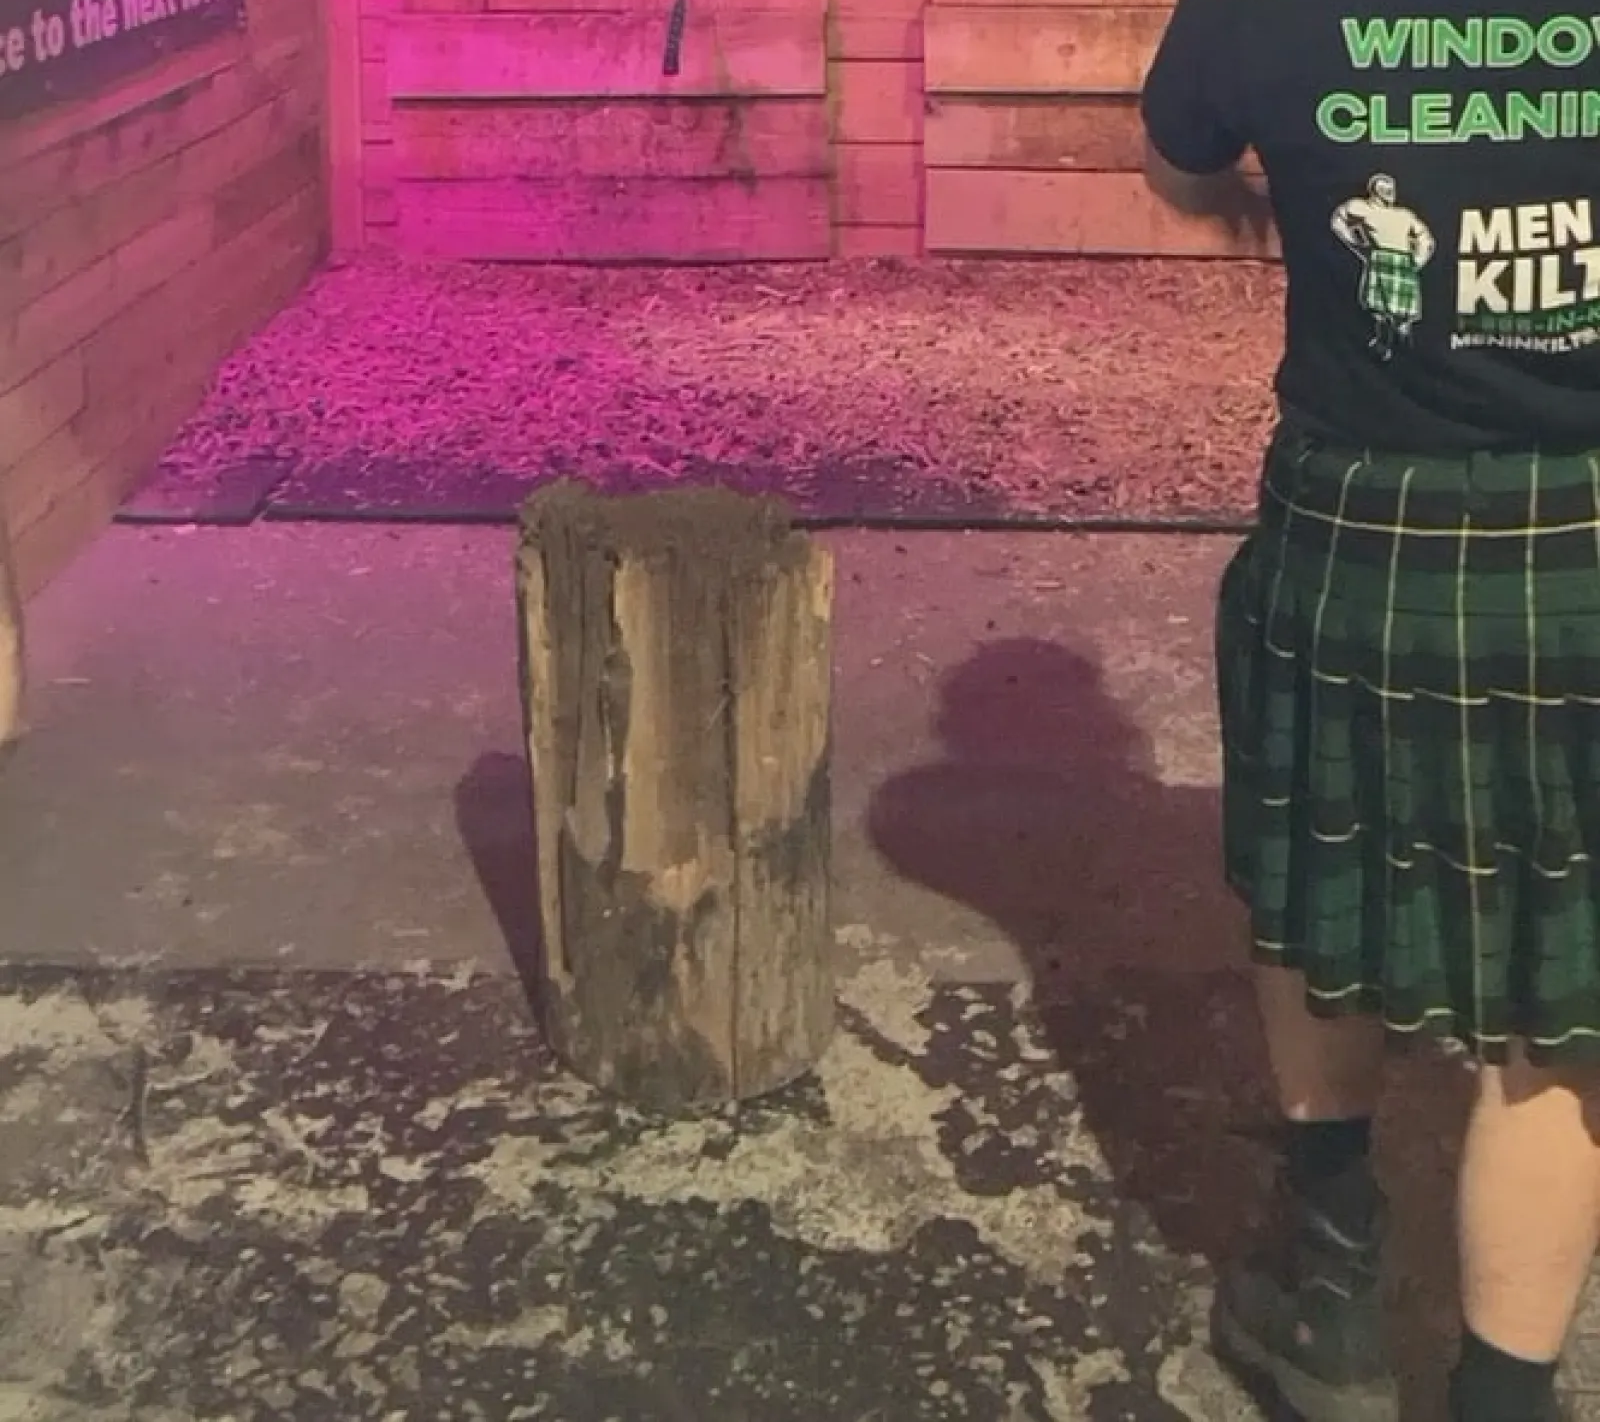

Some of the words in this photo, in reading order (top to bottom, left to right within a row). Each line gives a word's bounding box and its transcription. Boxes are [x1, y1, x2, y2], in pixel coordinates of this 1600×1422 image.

[32, 8, 65, 63] to
[1341, 15, 1600, 68] WINDO
[1458, 198, 1593, 254] MEN
